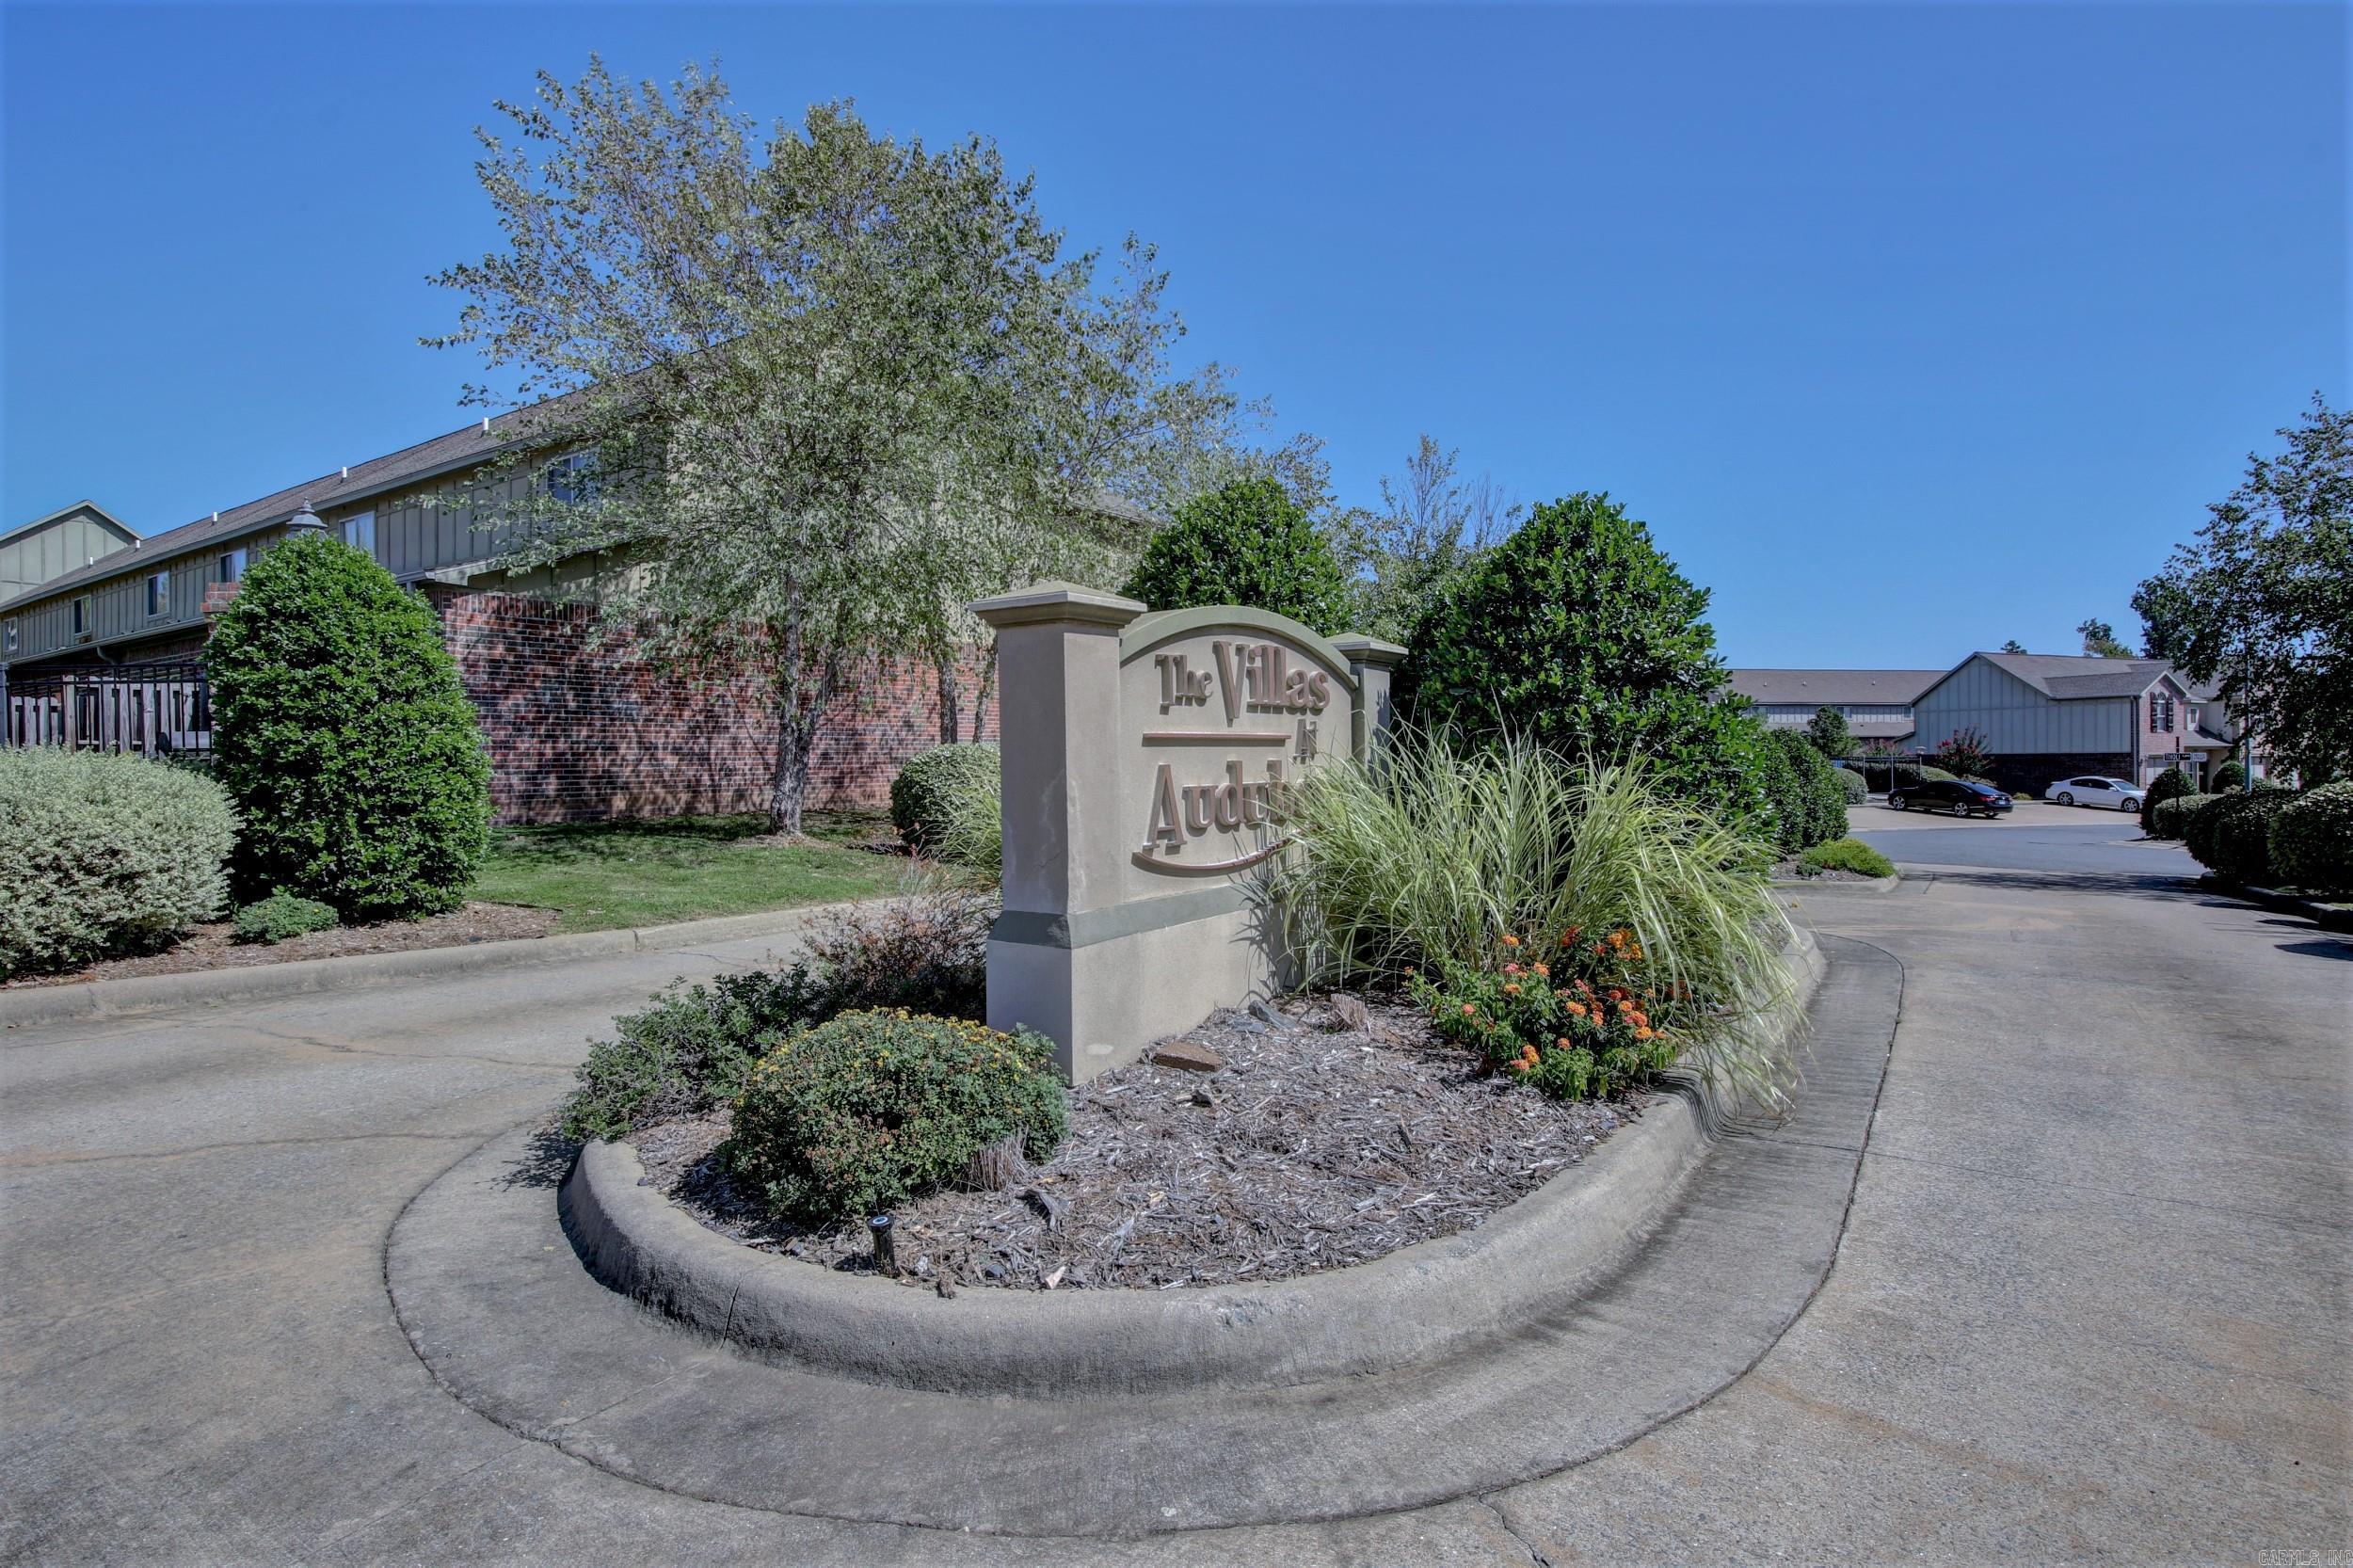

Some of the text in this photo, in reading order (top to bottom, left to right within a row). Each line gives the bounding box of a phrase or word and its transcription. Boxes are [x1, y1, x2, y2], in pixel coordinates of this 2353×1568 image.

[1155, 640, 1330, 718] The Villas
[1143, 759, 1308, 849] Audub
